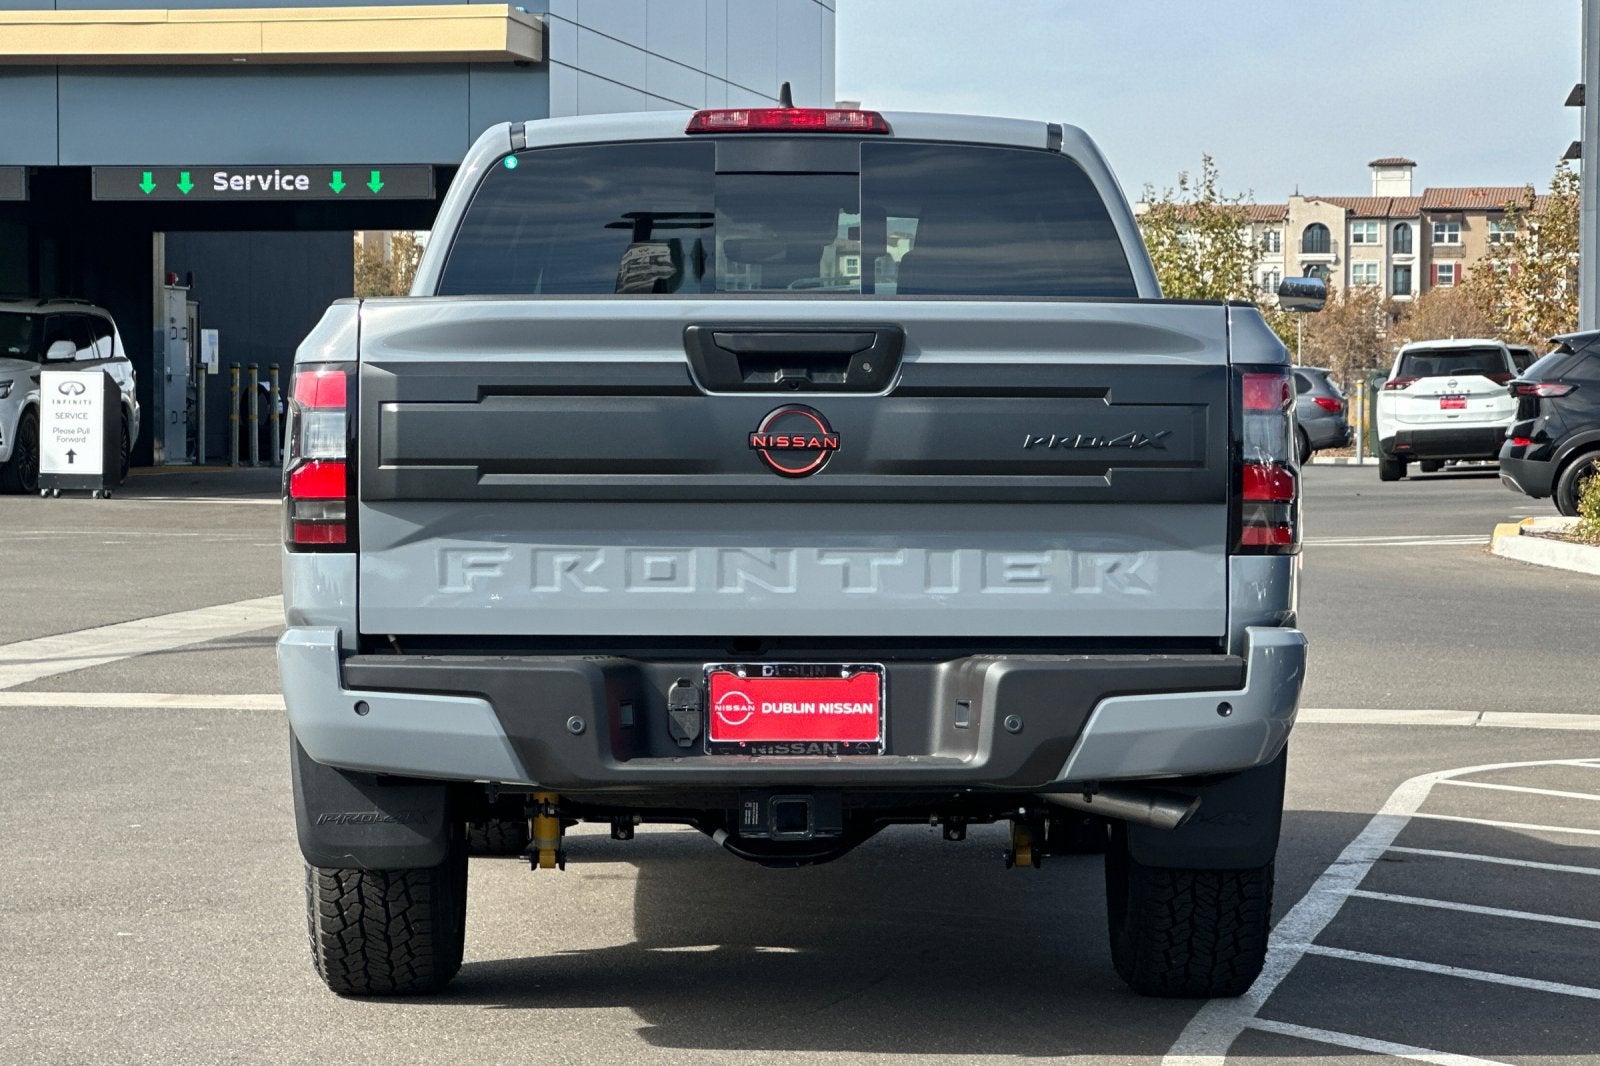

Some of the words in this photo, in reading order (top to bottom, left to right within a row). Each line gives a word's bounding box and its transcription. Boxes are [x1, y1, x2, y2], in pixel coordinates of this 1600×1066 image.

[213, 169, 310, 191] Service
[55, 412, 88, 420] SERVICE
[52, 426, 76, 435] Please
[76, 426, 91, 435] Pull
[56, 435, 87, 443] Forward
[752, 435, 837, 448] NISSAN
[437, 547, 1153, 594] FRONTIER
[714, 704, 756, 713] NISSAN
[761, 702, 815, 715] DUBLIN
[819, 702, 874, 715] NISSAN
[751, 742, 838, 755] NISSAN
